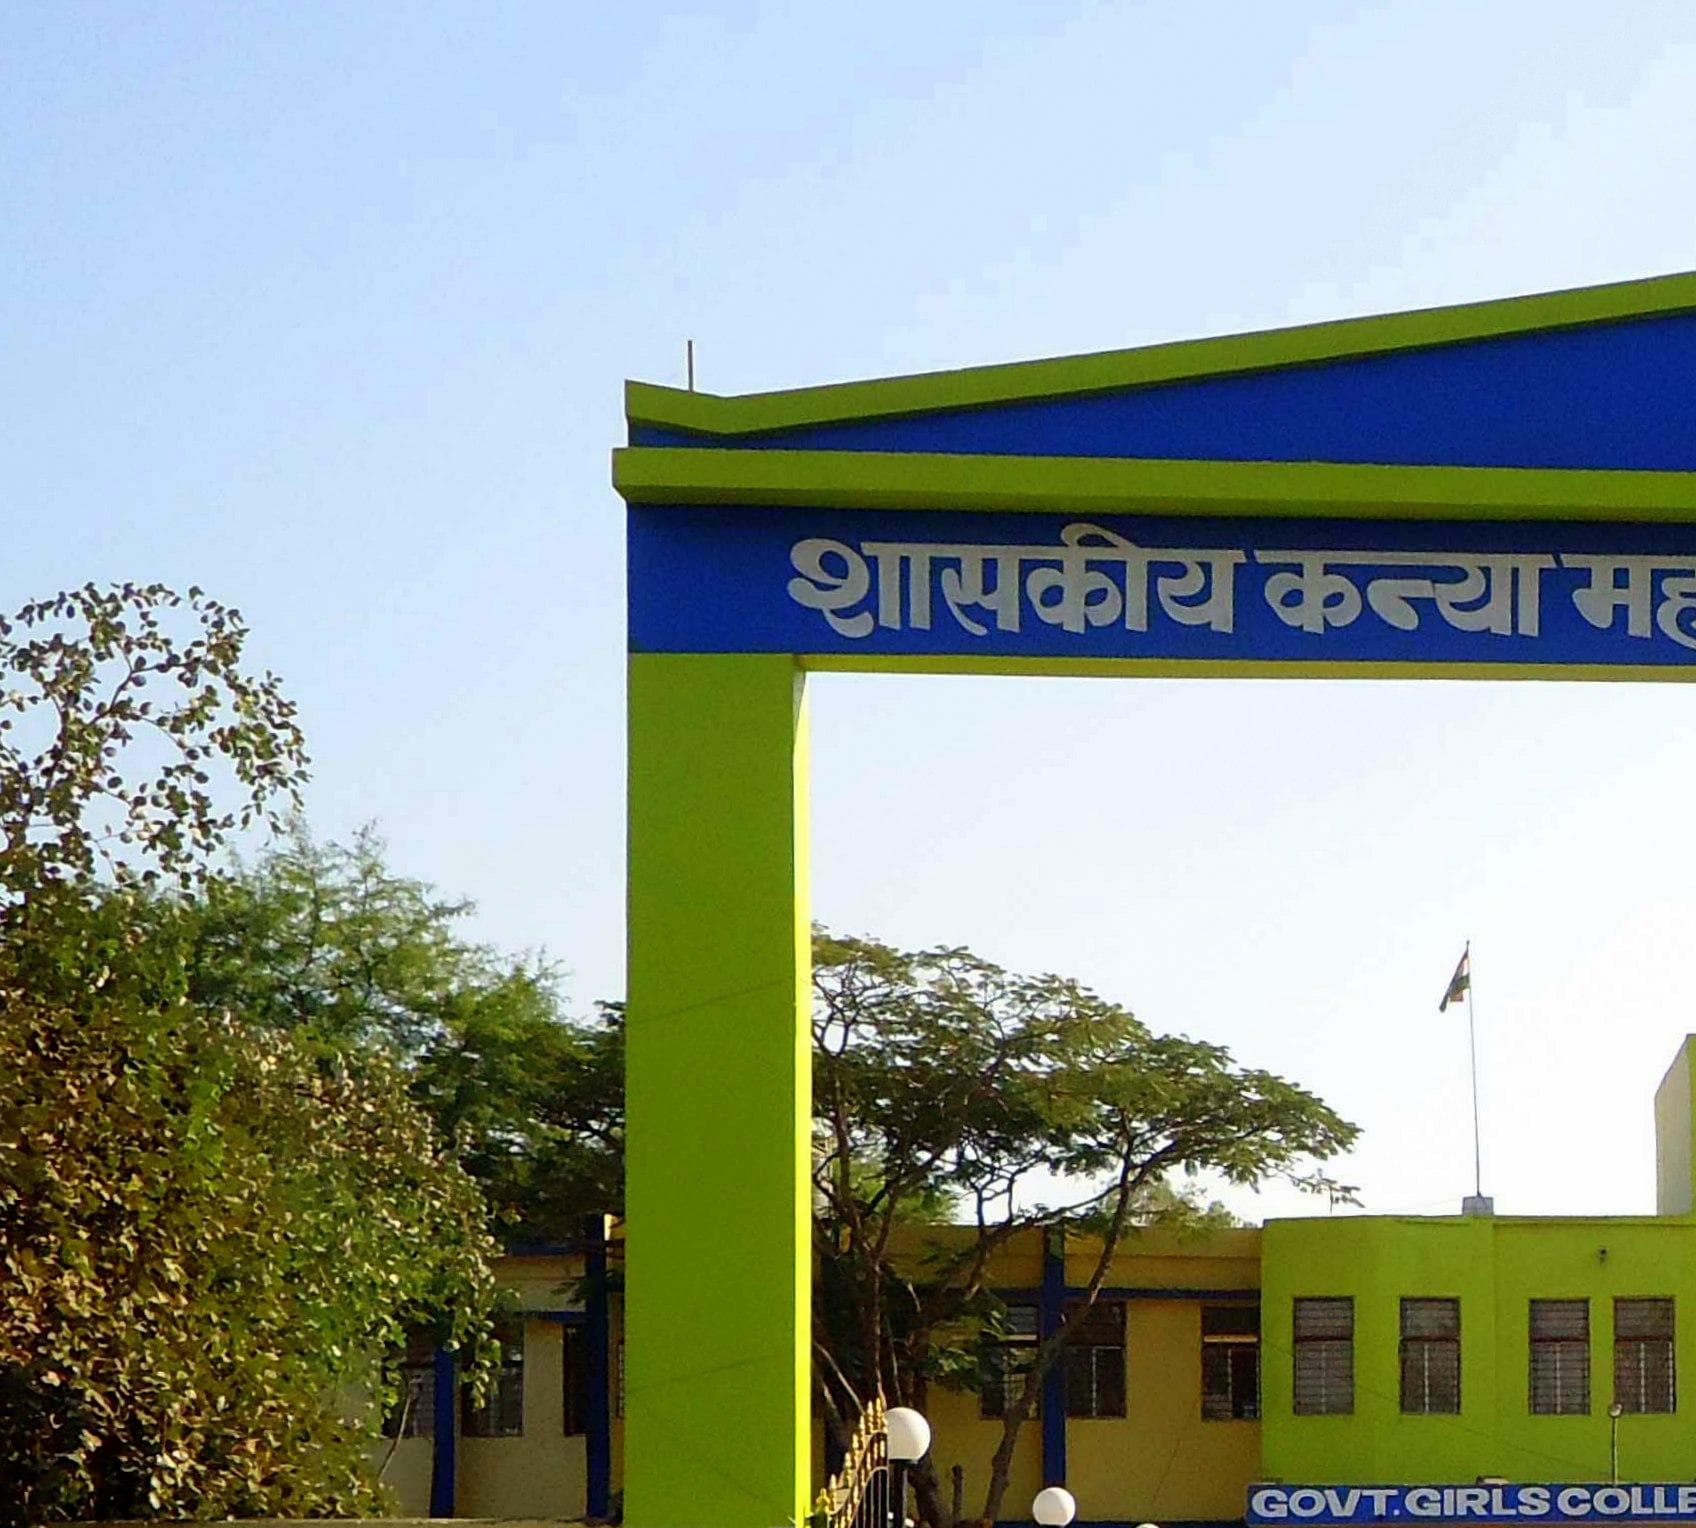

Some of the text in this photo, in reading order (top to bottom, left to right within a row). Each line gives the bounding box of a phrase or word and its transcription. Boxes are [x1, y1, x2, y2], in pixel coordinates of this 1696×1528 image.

[788, 523, 1245, 638] शासकीय
[1255, 550, 1555, 636] कन्या
[1405, 1487, 1551, 1516] GIRLS
